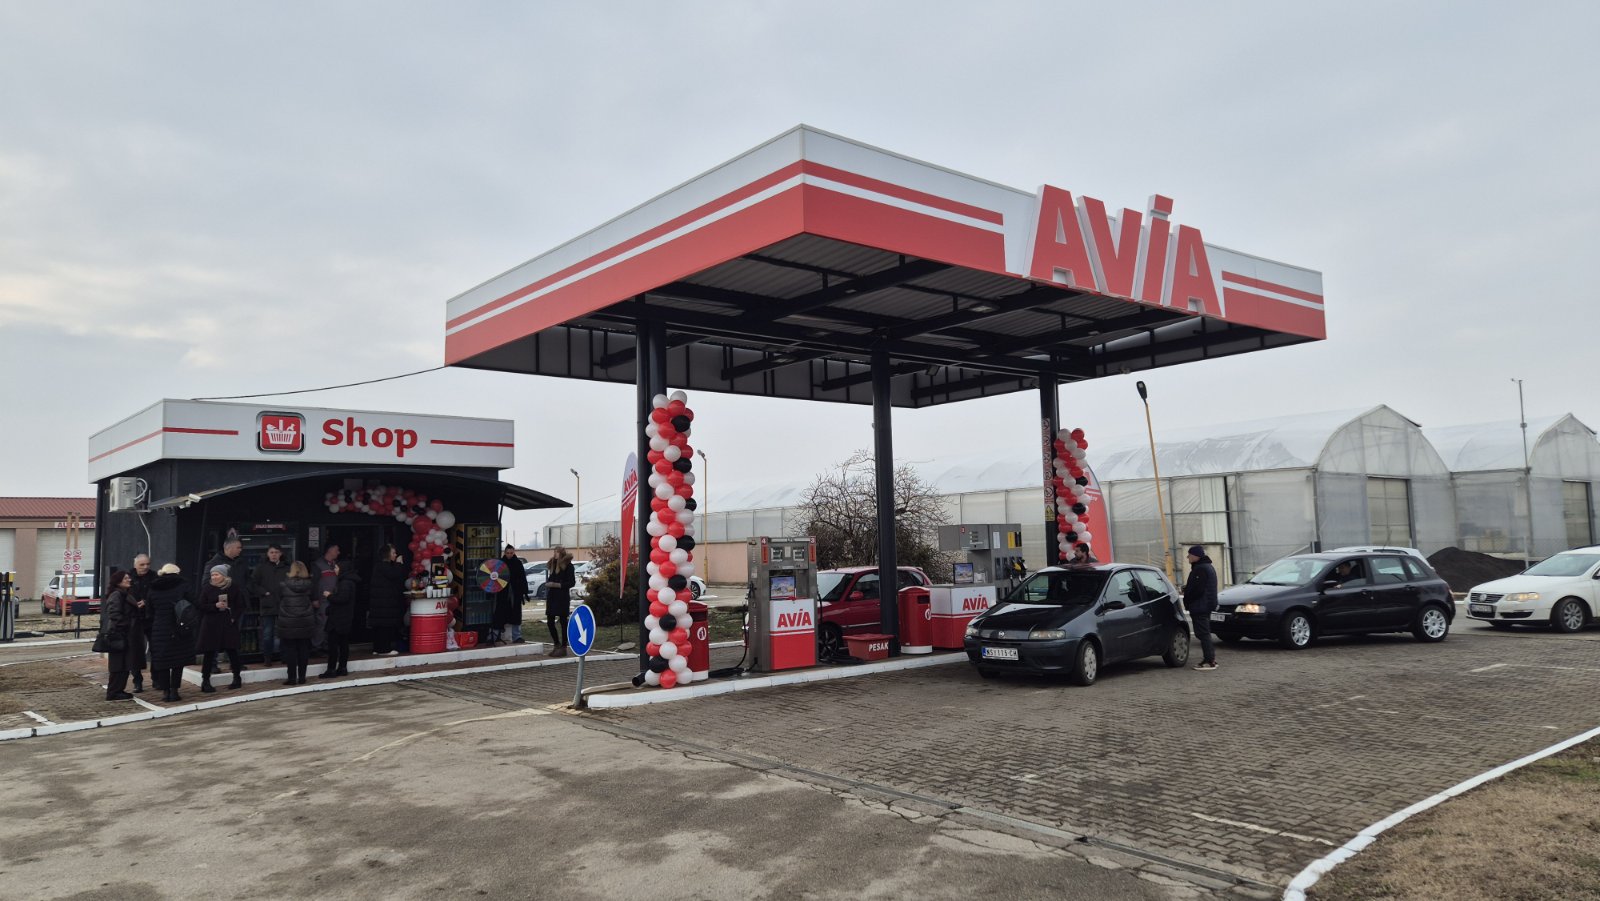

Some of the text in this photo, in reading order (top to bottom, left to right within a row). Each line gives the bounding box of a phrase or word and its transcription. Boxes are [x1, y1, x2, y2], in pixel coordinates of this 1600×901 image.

[321, 417, 418, 458] Shop
[962, 593, 989, 611] AVIA
[777, 608, 812, 628] AVIA
[868, 642, 889, 652] PESAK
